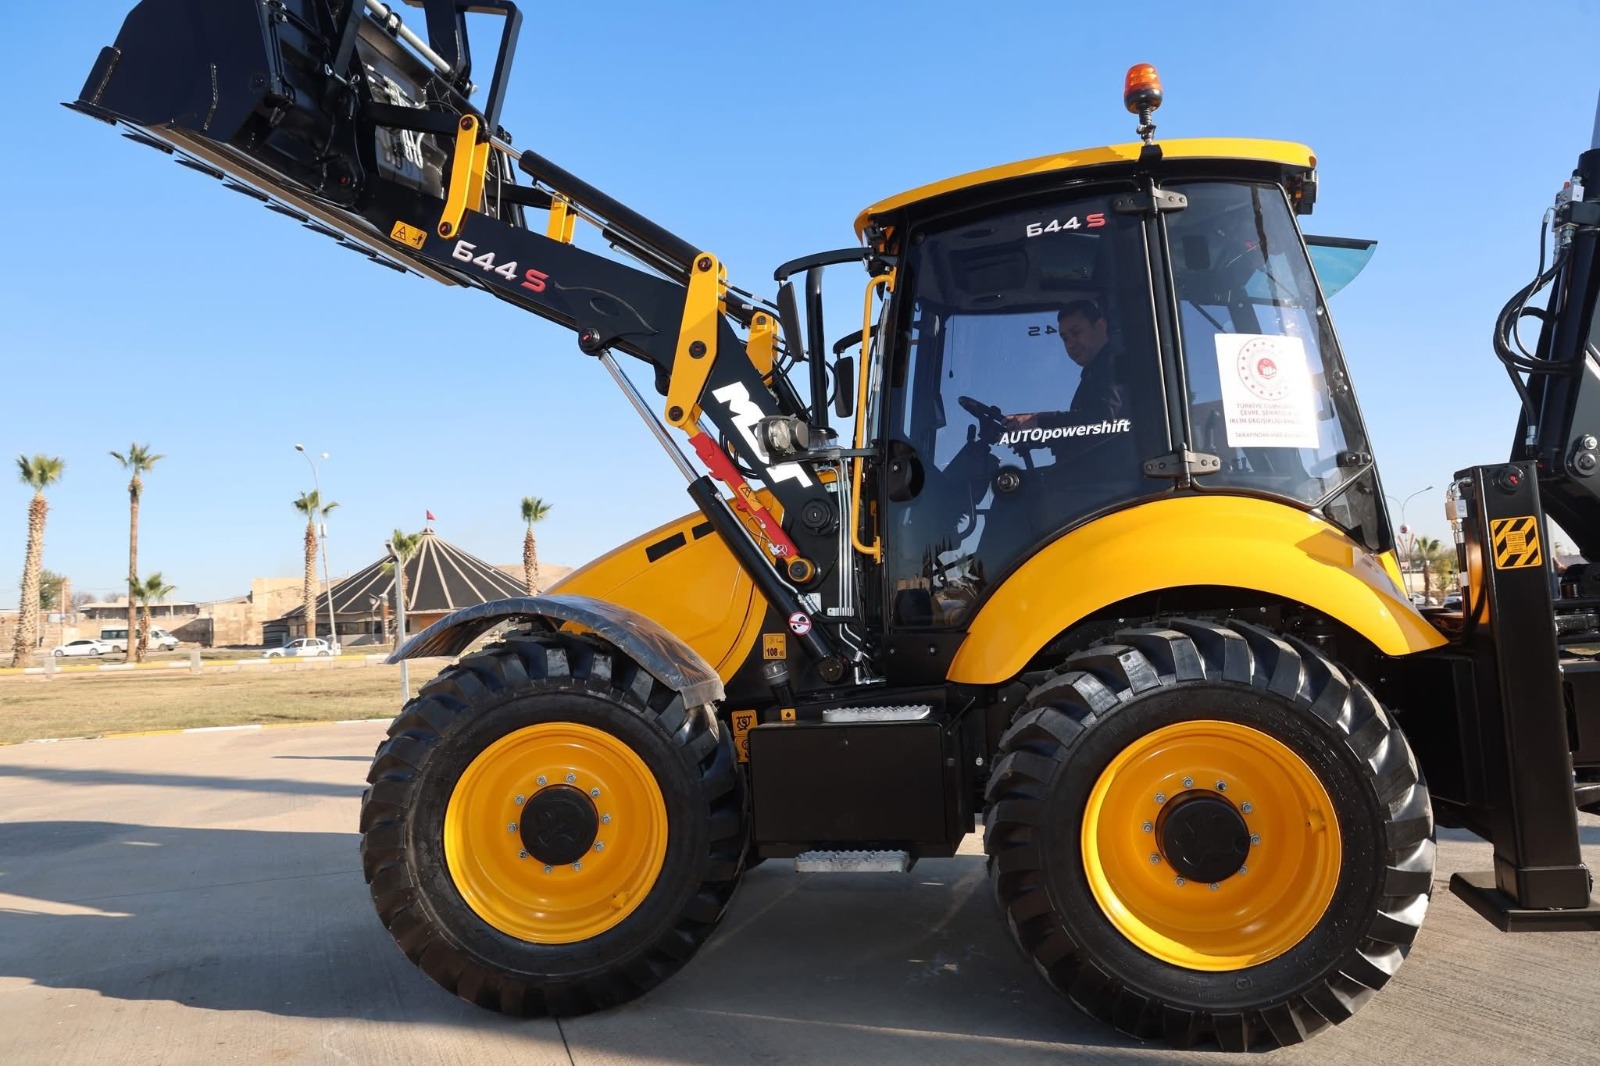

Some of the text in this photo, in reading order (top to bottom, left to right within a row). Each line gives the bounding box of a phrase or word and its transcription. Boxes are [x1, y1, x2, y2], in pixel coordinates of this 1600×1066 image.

[1026, 213, 1106, 238] 644 S
[452, 240, 550, 293] 644 S
[998, 418, 1131, 446] AUTOpowershift
